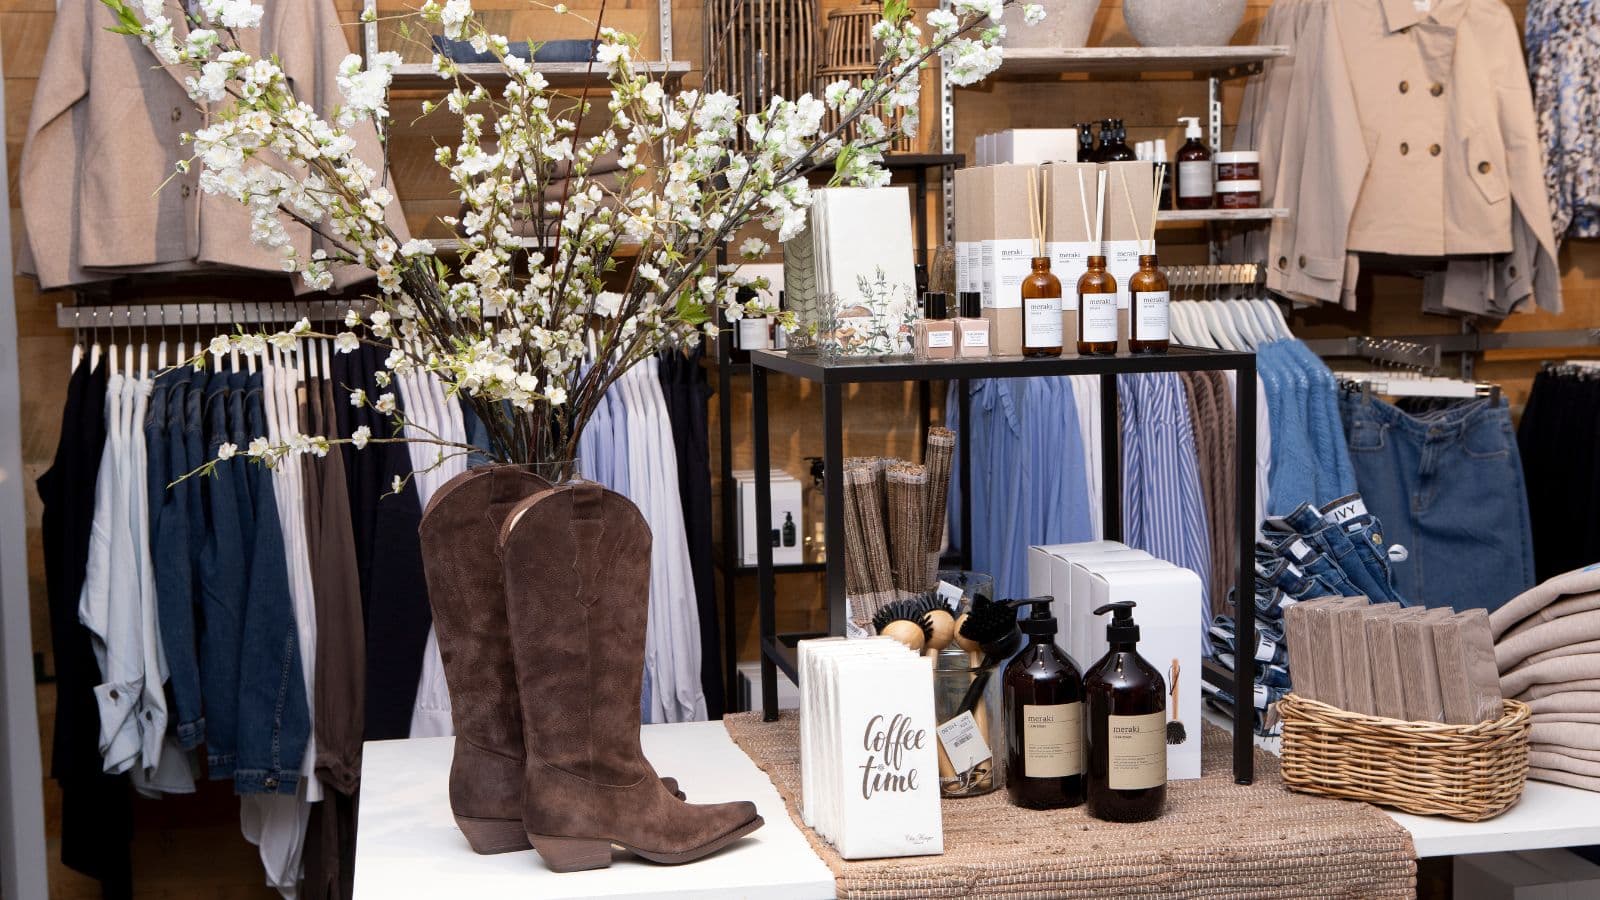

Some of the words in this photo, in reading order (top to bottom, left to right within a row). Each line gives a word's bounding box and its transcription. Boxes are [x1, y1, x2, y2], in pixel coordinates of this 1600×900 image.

[1001, 248, 1024, 256] meraki
[1334, 504, 1355, 521] IVY
[1113, 725, 1140, 733] meraki
[863, 713, 926, 771] Coffee
[858, 755, 919, 800] time
